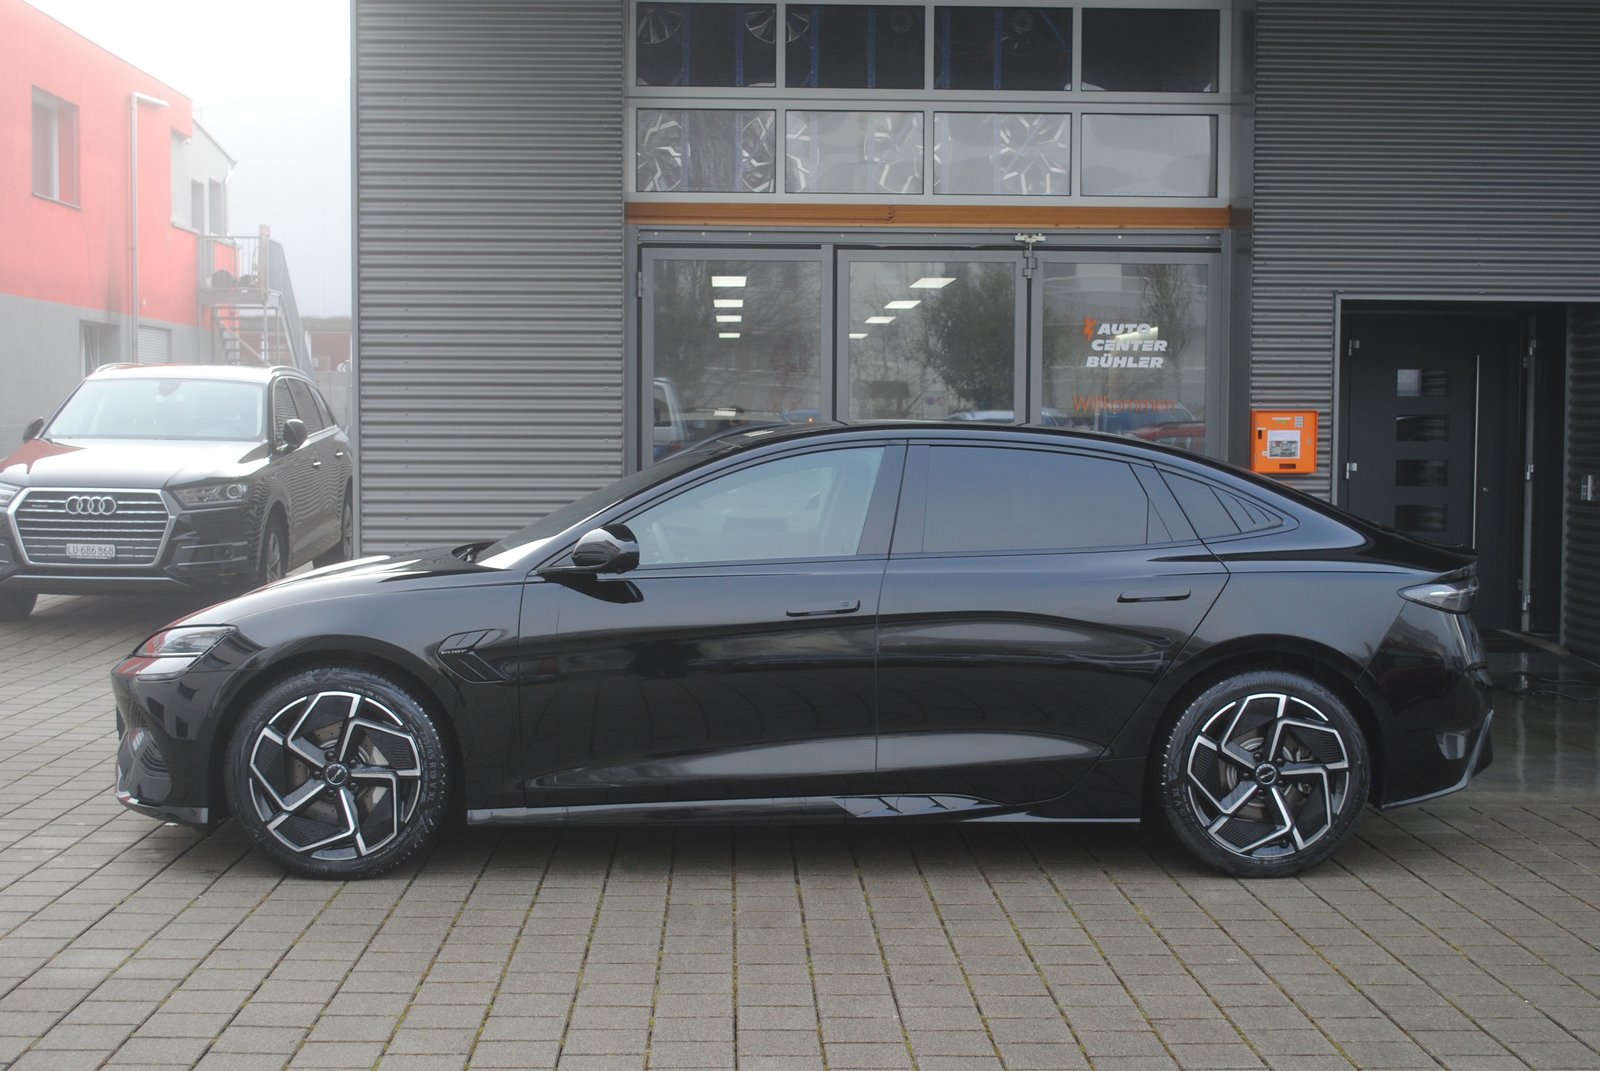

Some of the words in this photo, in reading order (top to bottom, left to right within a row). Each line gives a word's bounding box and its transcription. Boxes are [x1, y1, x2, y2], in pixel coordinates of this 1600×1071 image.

[1097, 323, 1152, 335] AUTO
[1091, 339, 1168, 352] CENTER
[1085, 353, 1165, 368] BÜHLER
[1073, 395, 1177, 415] Willkommen
[67, 545, 79, 555] LU
